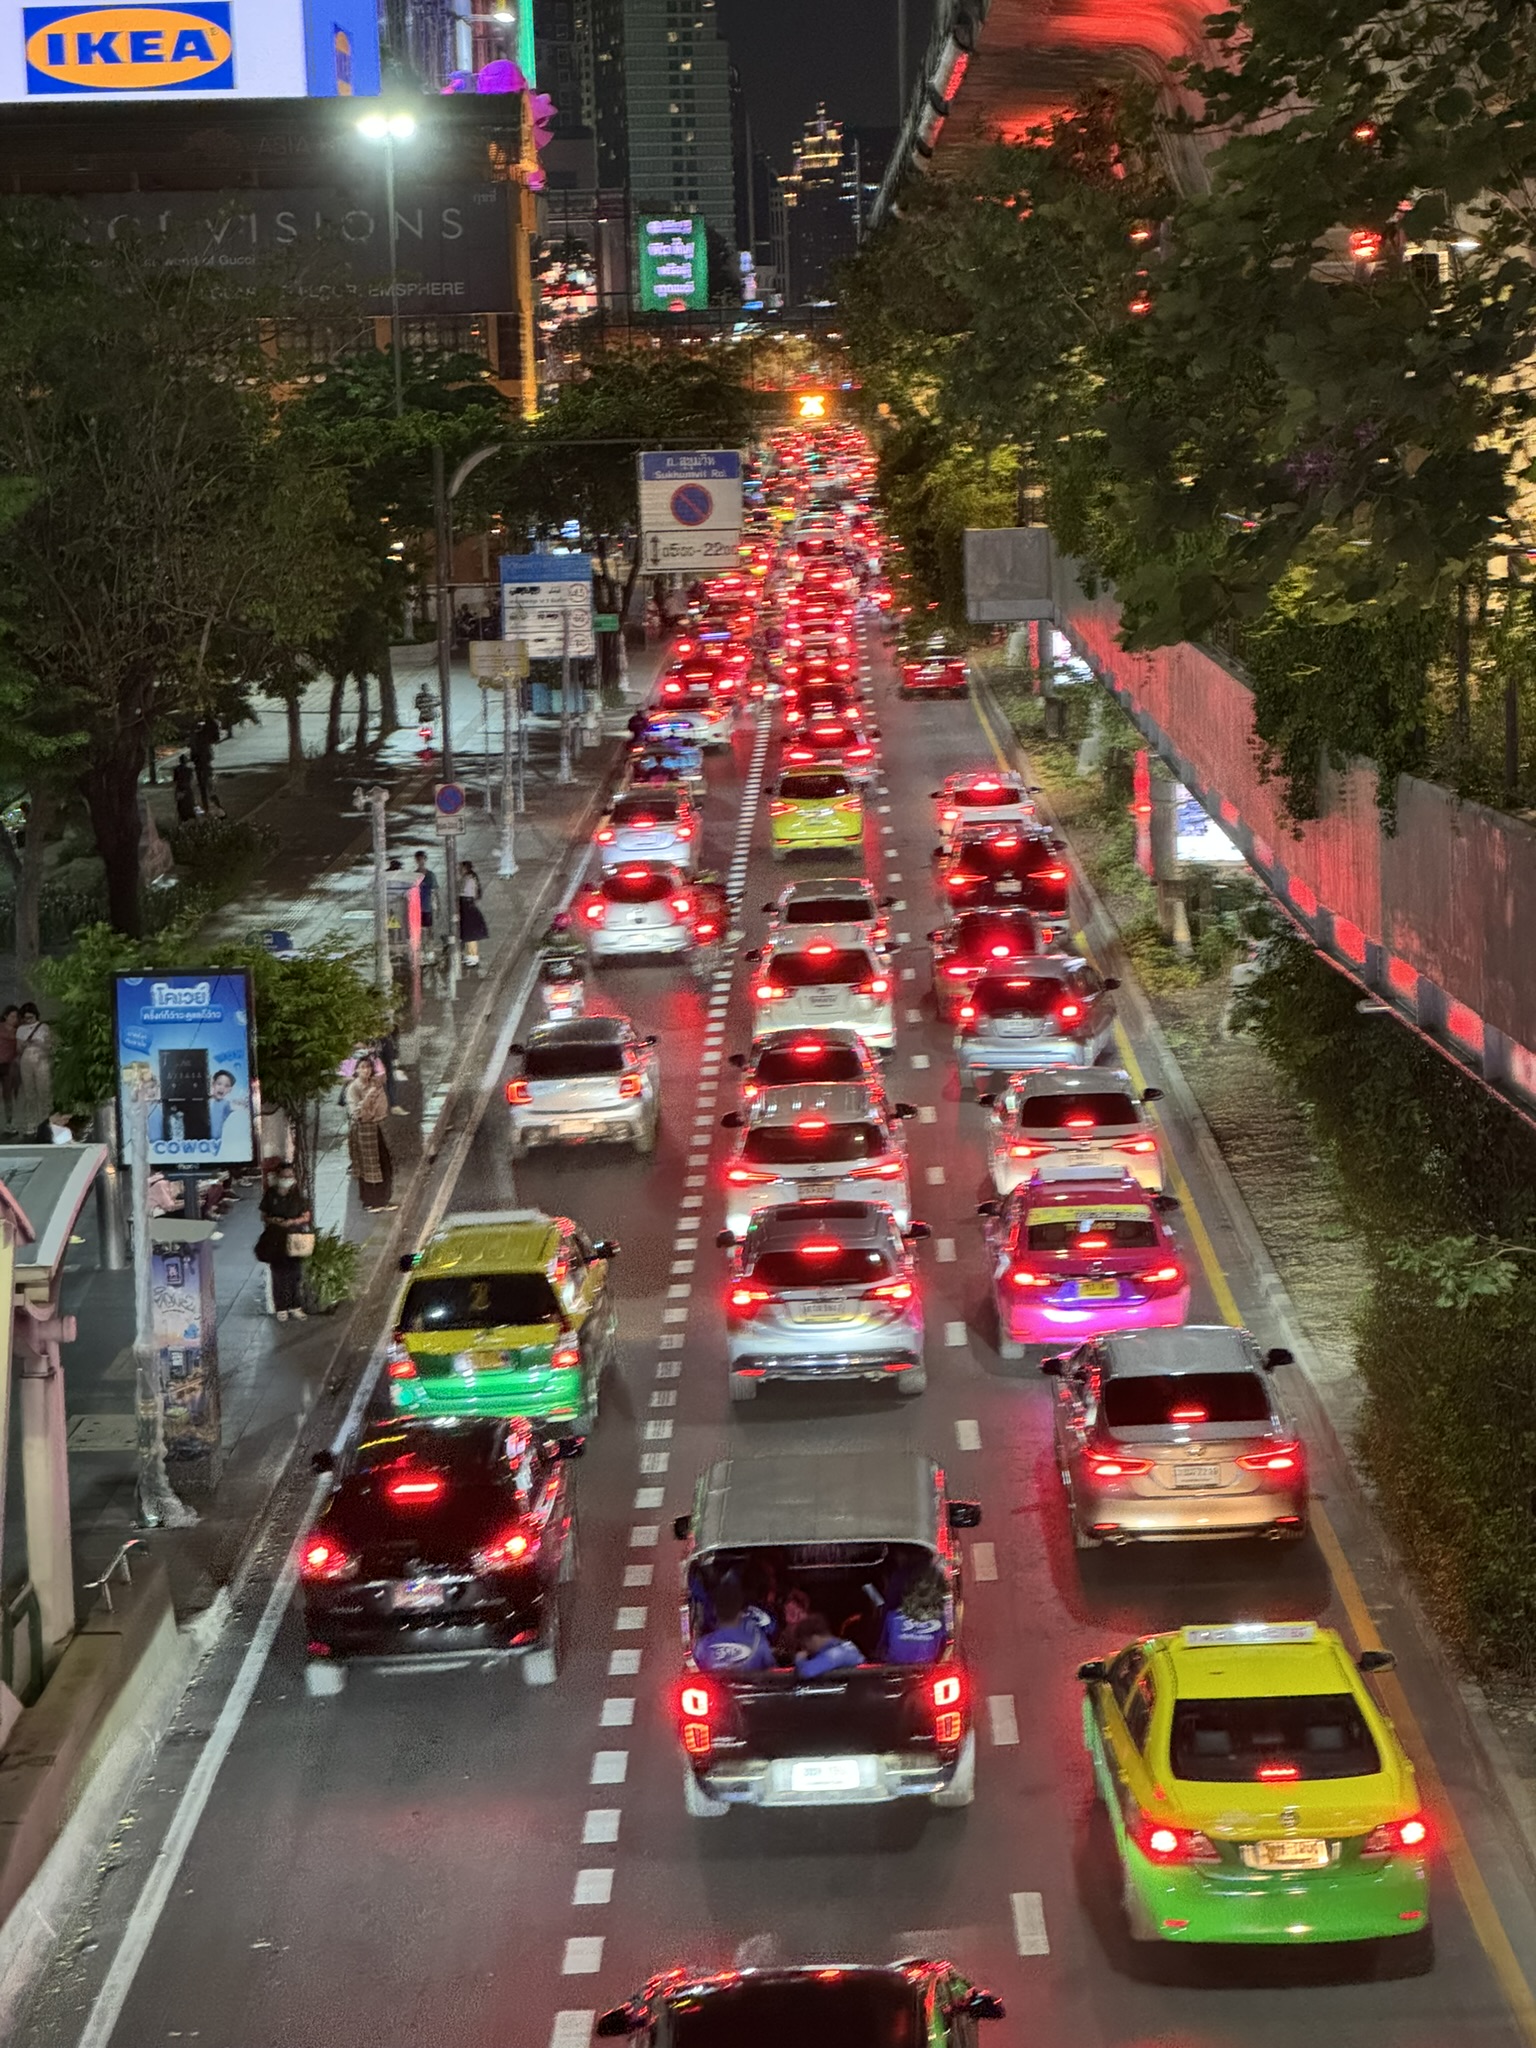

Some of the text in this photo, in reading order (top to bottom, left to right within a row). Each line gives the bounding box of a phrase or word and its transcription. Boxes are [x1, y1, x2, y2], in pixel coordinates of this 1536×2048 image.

[46, 29, 218, 66] IKEA
[218, 253, 256, 267] Gucci
[367, 281, 465, 298] EMSPHERE
[655, 470, 707, 479] Sukhumvit
[156, 984, 207, 1005] โคเวย์
